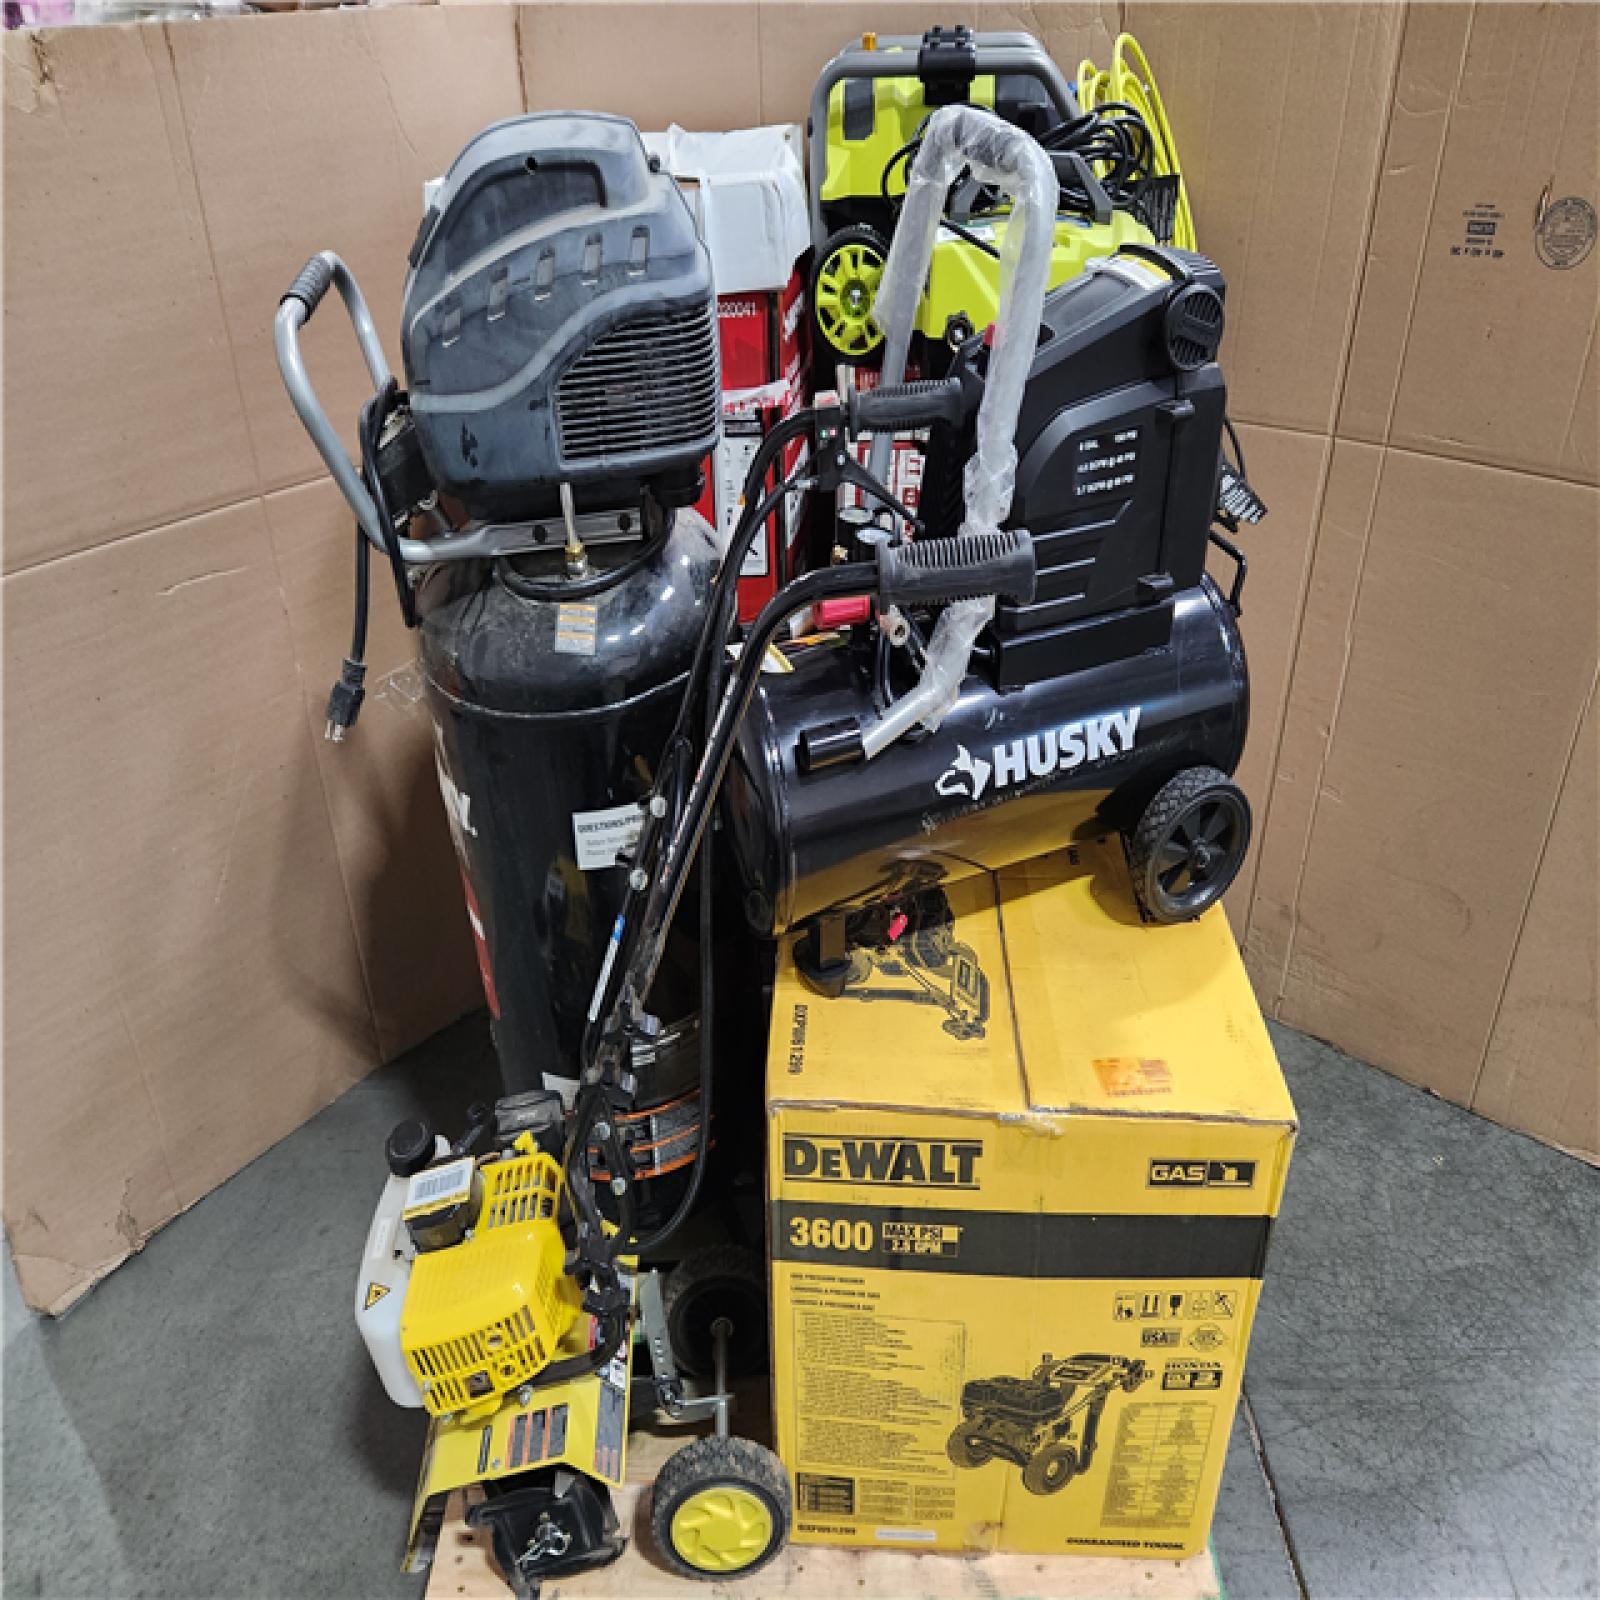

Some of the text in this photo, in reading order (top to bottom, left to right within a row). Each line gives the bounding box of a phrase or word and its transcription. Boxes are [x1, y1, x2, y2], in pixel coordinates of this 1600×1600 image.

[992, 706, 1142, 789] HUSKY
[1151, 1164, 1207, 1182] GAS
[789, 1216, 874, 1252] 3600
